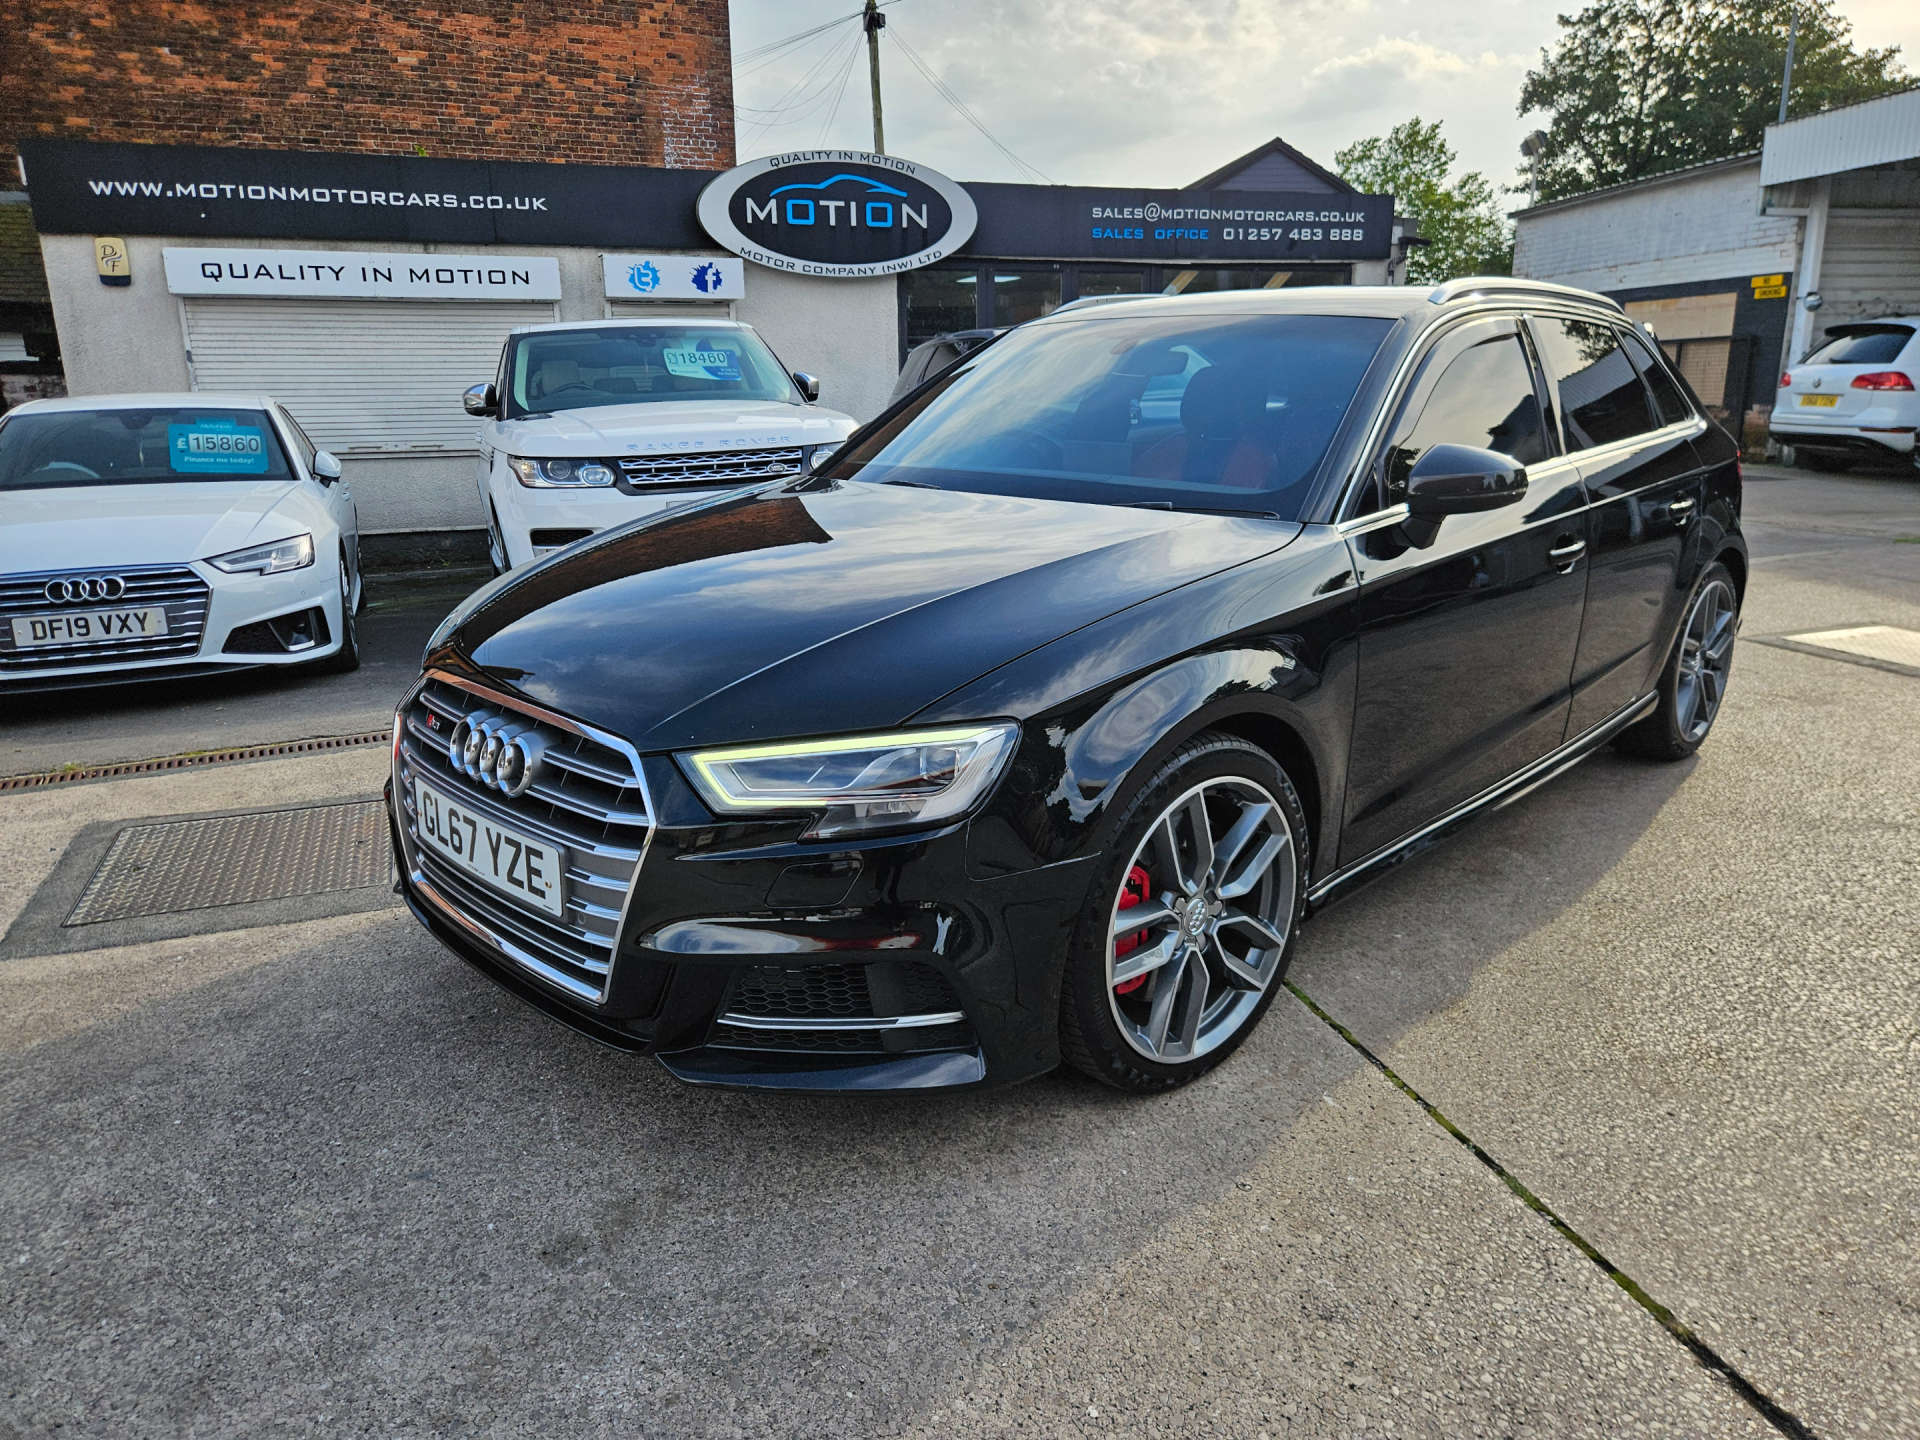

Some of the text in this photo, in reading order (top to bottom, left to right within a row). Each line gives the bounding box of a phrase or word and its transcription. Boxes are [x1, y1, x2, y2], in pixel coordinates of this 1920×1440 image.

[769, 151, 917, 175] QUALITY IN MOTION
[88, 180, 549, 212] WWW.MOTIONMOTORCARS.CO.UK
[745, 197, 929, 230] MOTION
[1092, 202, 1366, 223] SALES@MOTIONMOTORCARS.CO.UK
[1092, 227, 1364, 242] SALES OFFICE 01257 483 888
[201, 262, 530, 286] QUALITY IN MOTION
[739, 246, 943, 276] MOTOR COMPANY (NW) LTD
[30, 611, 149, 642] DF19 VXY
[422, 790, 547, 900] GL67 YZE
